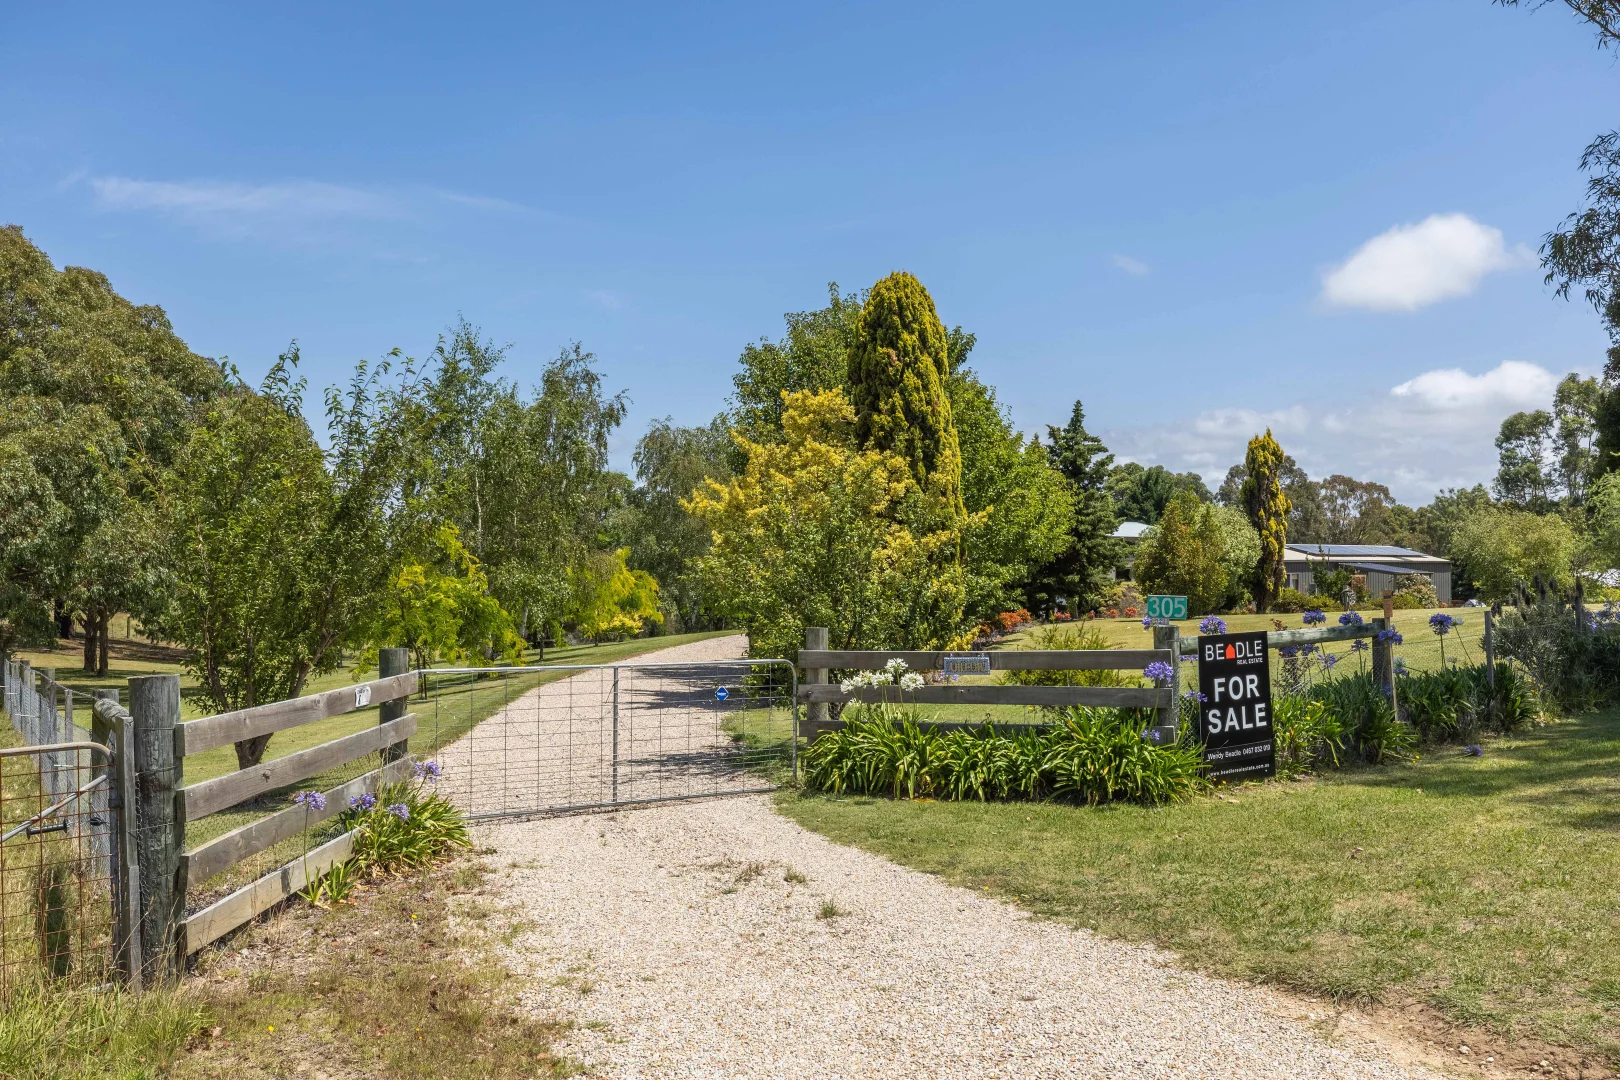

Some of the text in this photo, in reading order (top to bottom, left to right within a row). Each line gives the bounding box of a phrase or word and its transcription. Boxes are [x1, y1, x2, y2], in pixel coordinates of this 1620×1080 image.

[1149, 597, 1185, 617] 305
[1214, 674, 1260, 702] FOR
[1208, 703, 1267, 733] SALE
[1207, 752, 1224, 760] Wendy
[1225, 750, 1241, 758] Beadle
